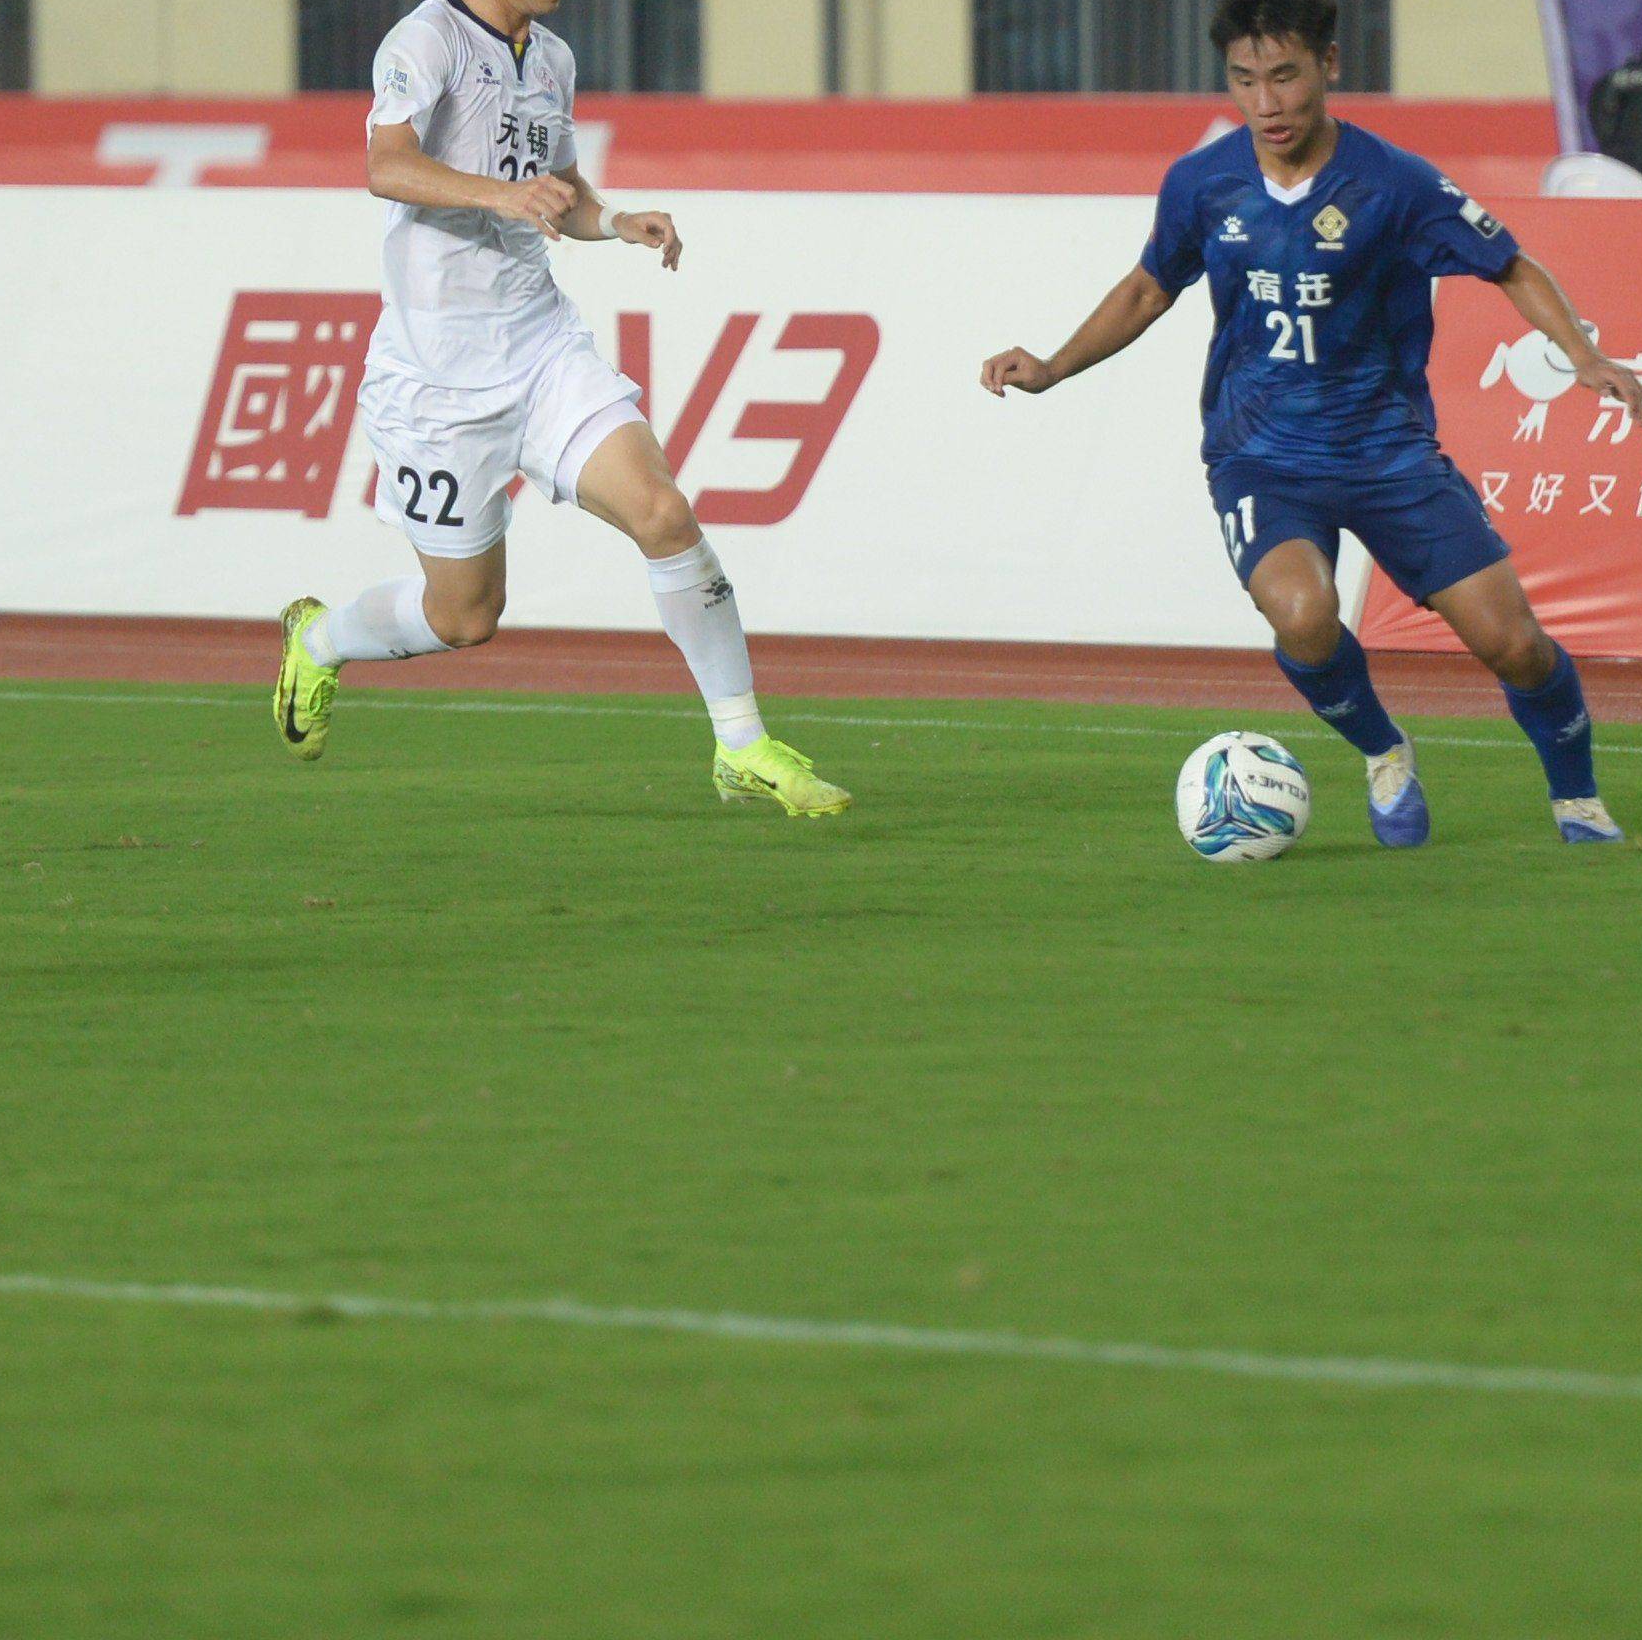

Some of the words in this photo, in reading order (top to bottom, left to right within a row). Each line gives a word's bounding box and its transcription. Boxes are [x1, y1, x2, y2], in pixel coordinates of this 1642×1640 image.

[496, 113, 549, 160] 无锡
[1246, 269, 1334, 307] 宿迁
[1265, 310, 1317, 364] 21
[396, 465, 464, 527] 22
